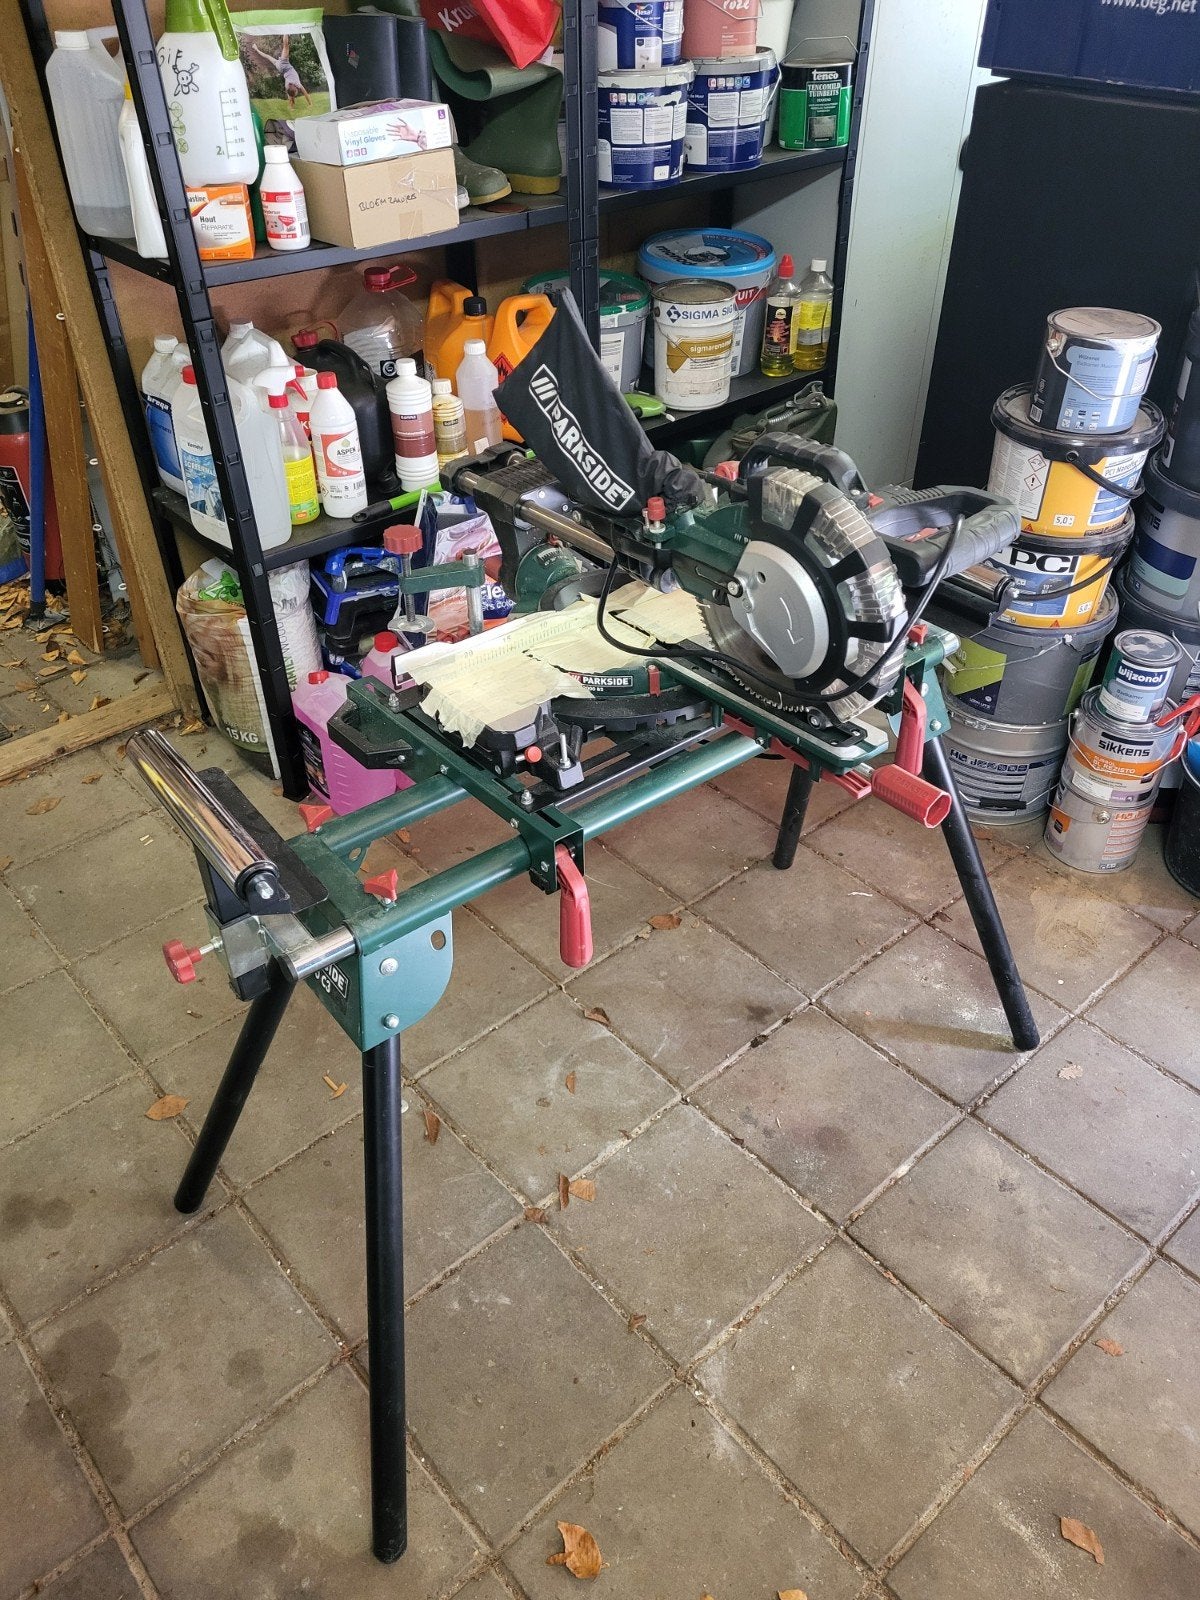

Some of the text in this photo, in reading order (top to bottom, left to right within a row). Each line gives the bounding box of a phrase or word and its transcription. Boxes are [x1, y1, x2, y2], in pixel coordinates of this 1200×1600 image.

[812, 69, 839, 80] tenco
[200, 215, 216, 223] Hout
[682, 310, 720, 320] SIGMA
[551, 403, 624, 503] PARKSIDE
[1010, 548, 1079, 573] PCI
[582, 676, 629, 686] PARKSIDE
